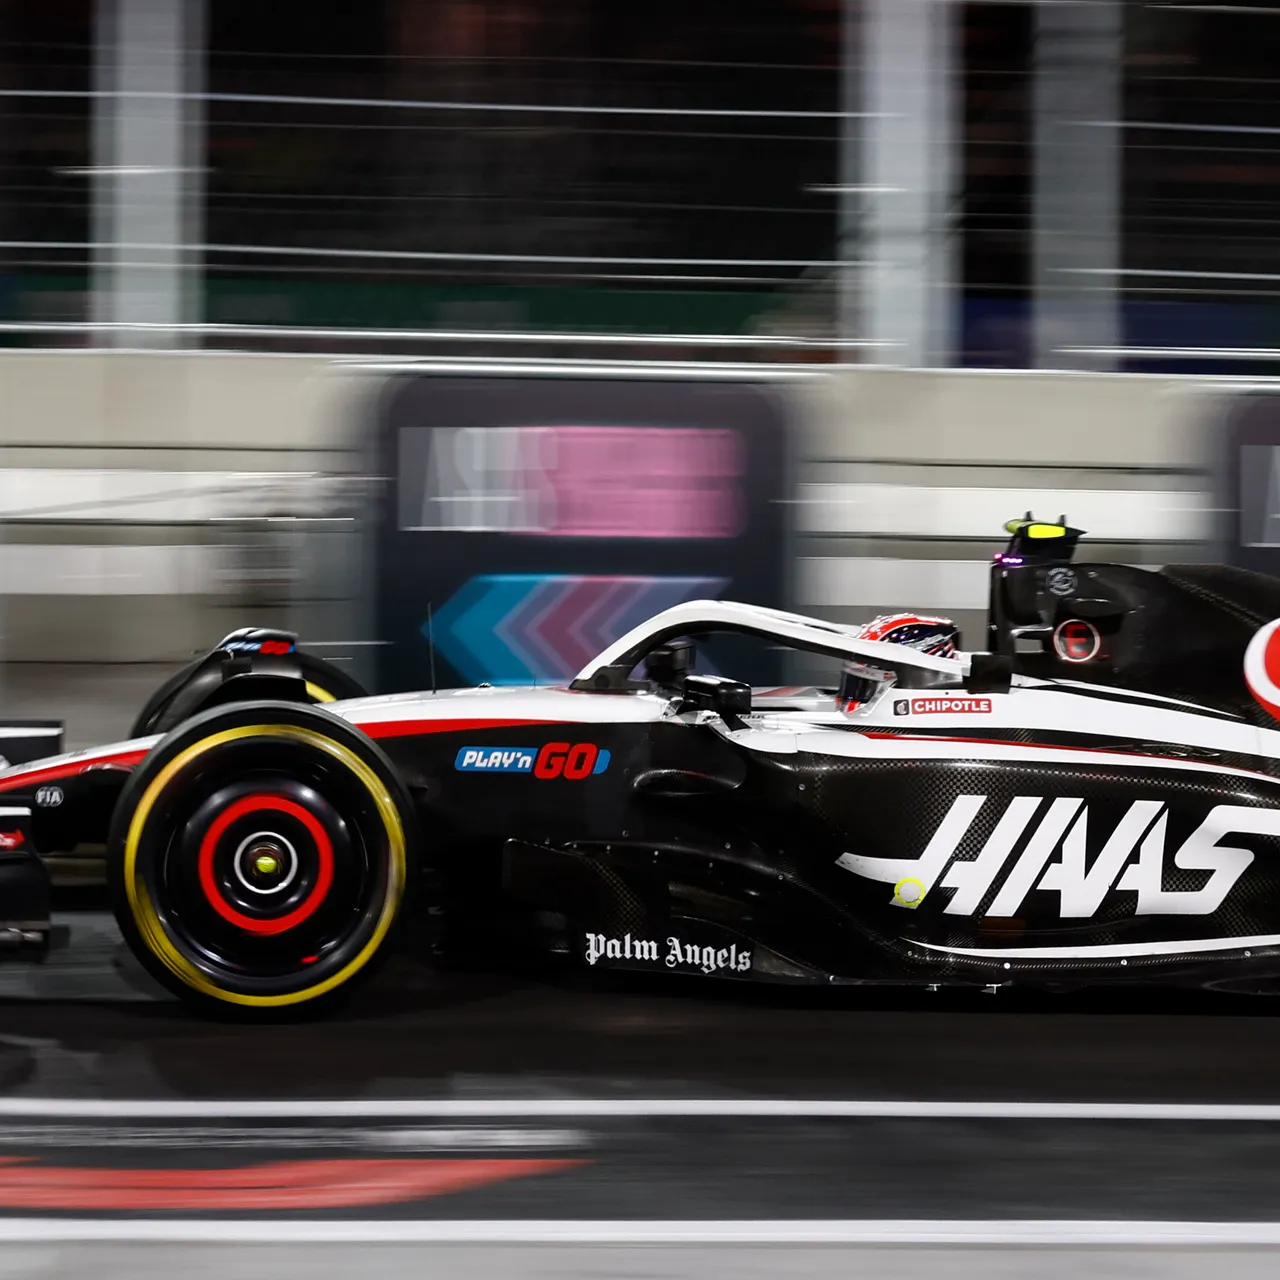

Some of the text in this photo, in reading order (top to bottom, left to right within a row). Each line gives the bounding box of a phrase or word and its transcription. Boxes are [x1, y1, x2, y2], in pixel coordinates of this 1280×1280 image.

[914, 700, 990, 713] CHIPOTLE
[534, 742, 597, 779] GO
[585, 933, 751, 974] Palm Angels
